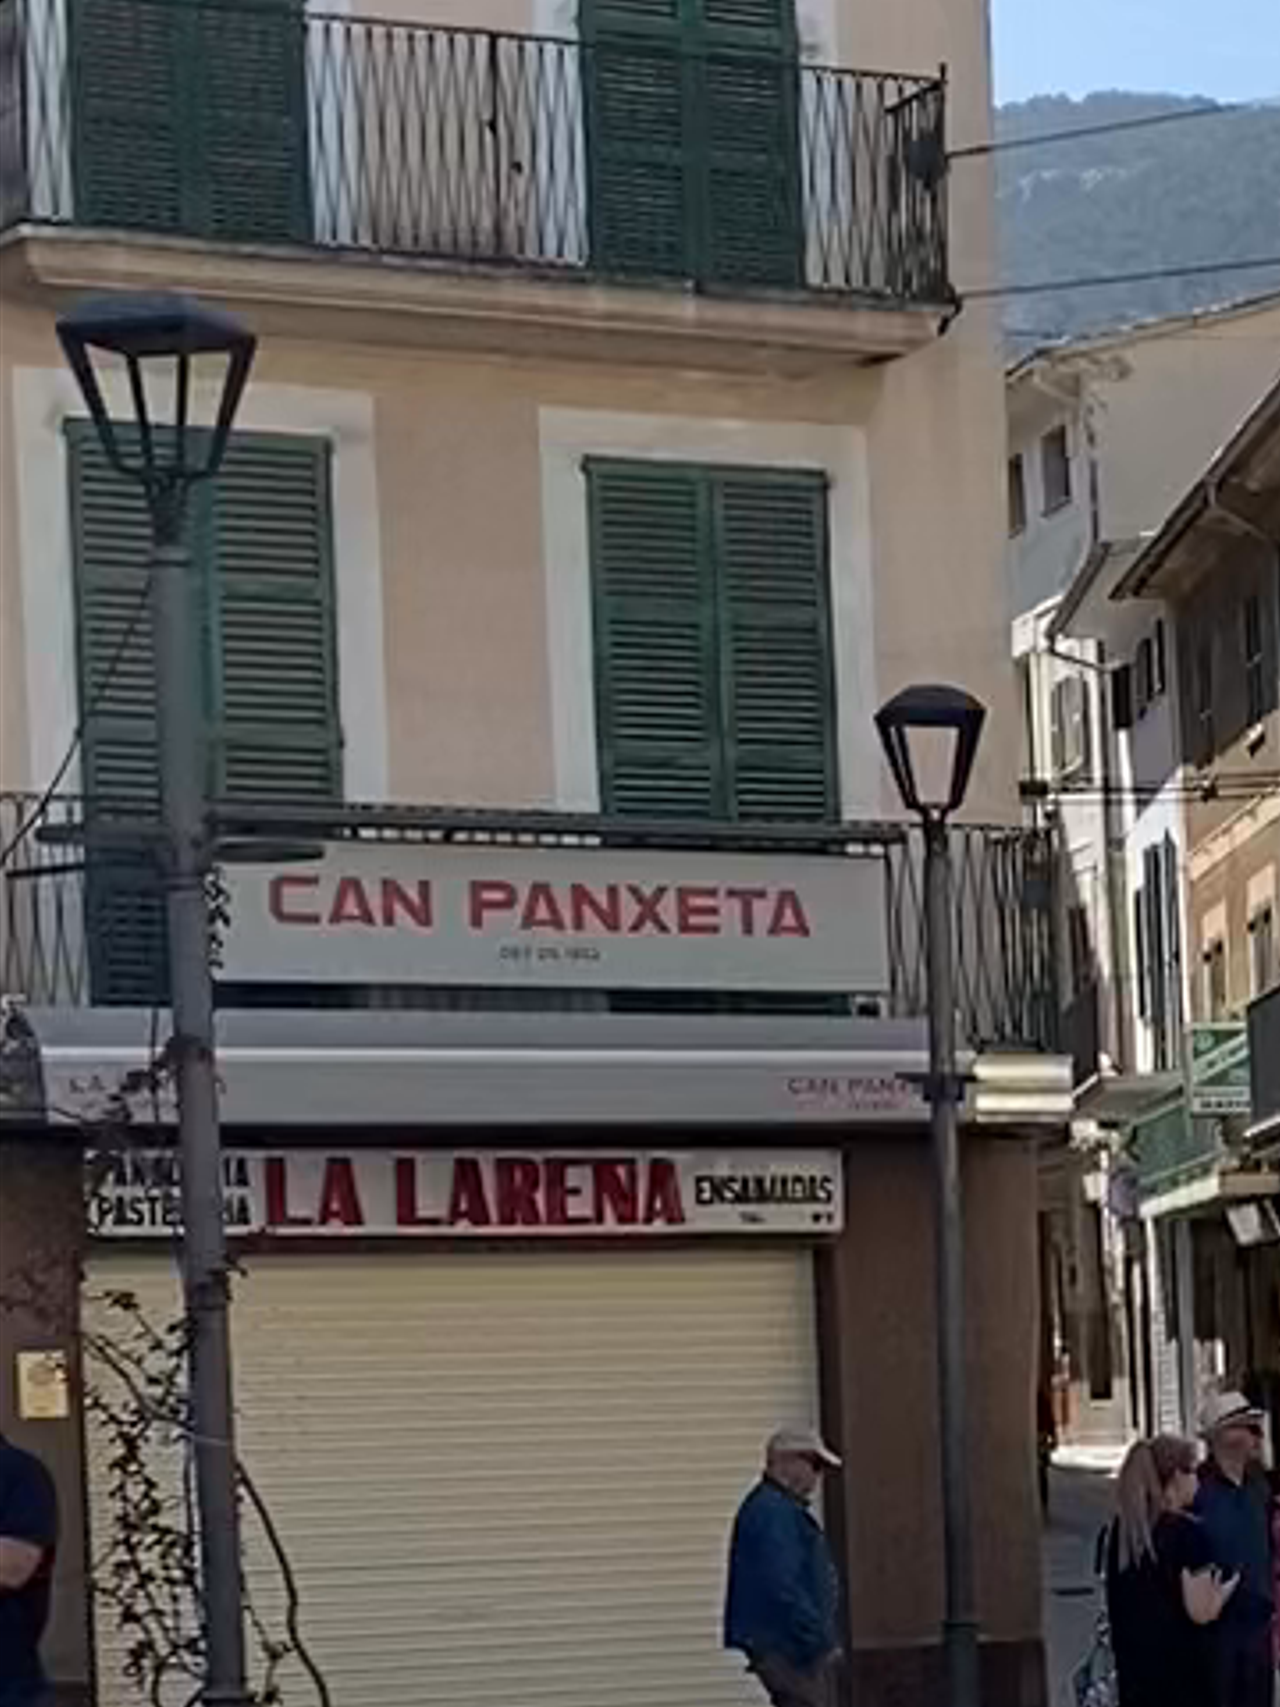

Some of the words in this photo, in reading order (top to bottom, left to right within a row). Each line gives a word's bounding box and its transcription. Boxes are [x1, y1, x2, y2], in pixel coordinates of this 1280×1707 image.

[268, 875, 433, 928] CAN
[468, 879, 811, 937] PANXETA
[264, 1156, 365, 1225] LA
